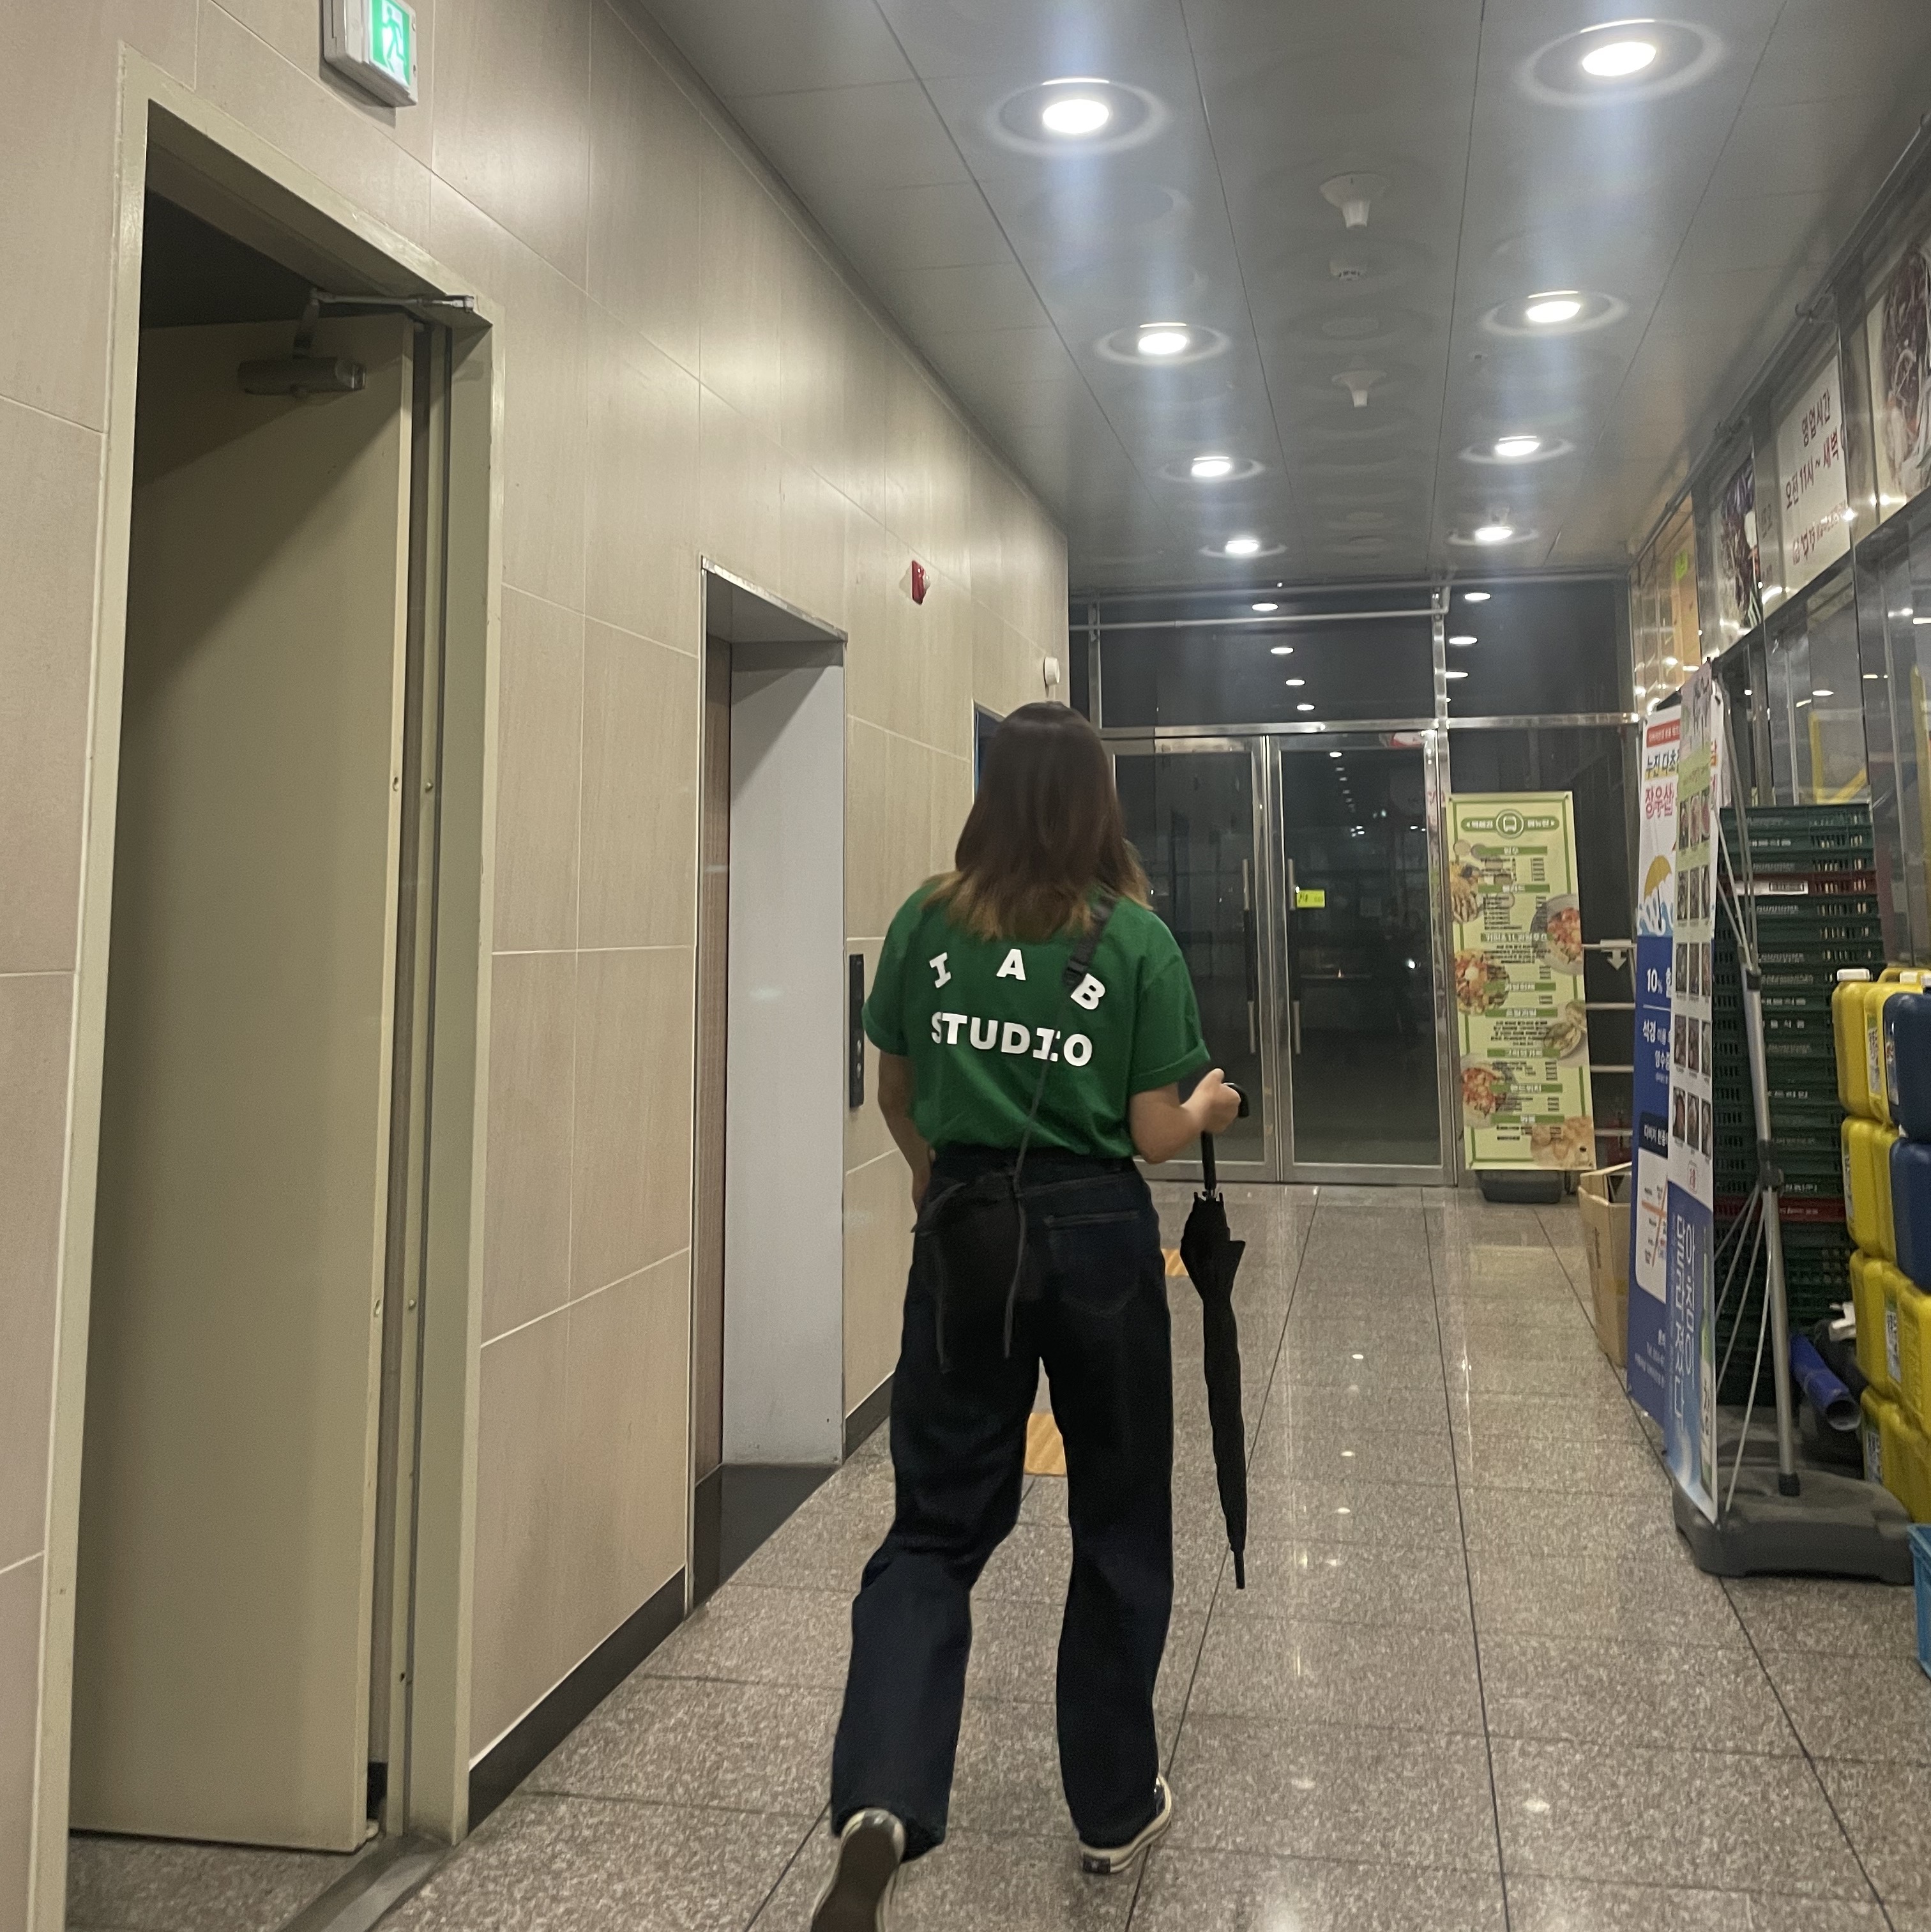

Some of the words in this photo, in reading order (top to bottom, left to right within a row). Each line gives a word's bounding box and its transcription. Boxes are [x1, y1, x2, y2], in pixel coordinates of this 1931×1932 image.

[1801, 388, 1831, 447] 영업시간
[1824, 427, 1839, 468] 새벽
[1646, 782, 1674, 819] 장우산
[931, 1011, 1093, 1067] STUDIO
